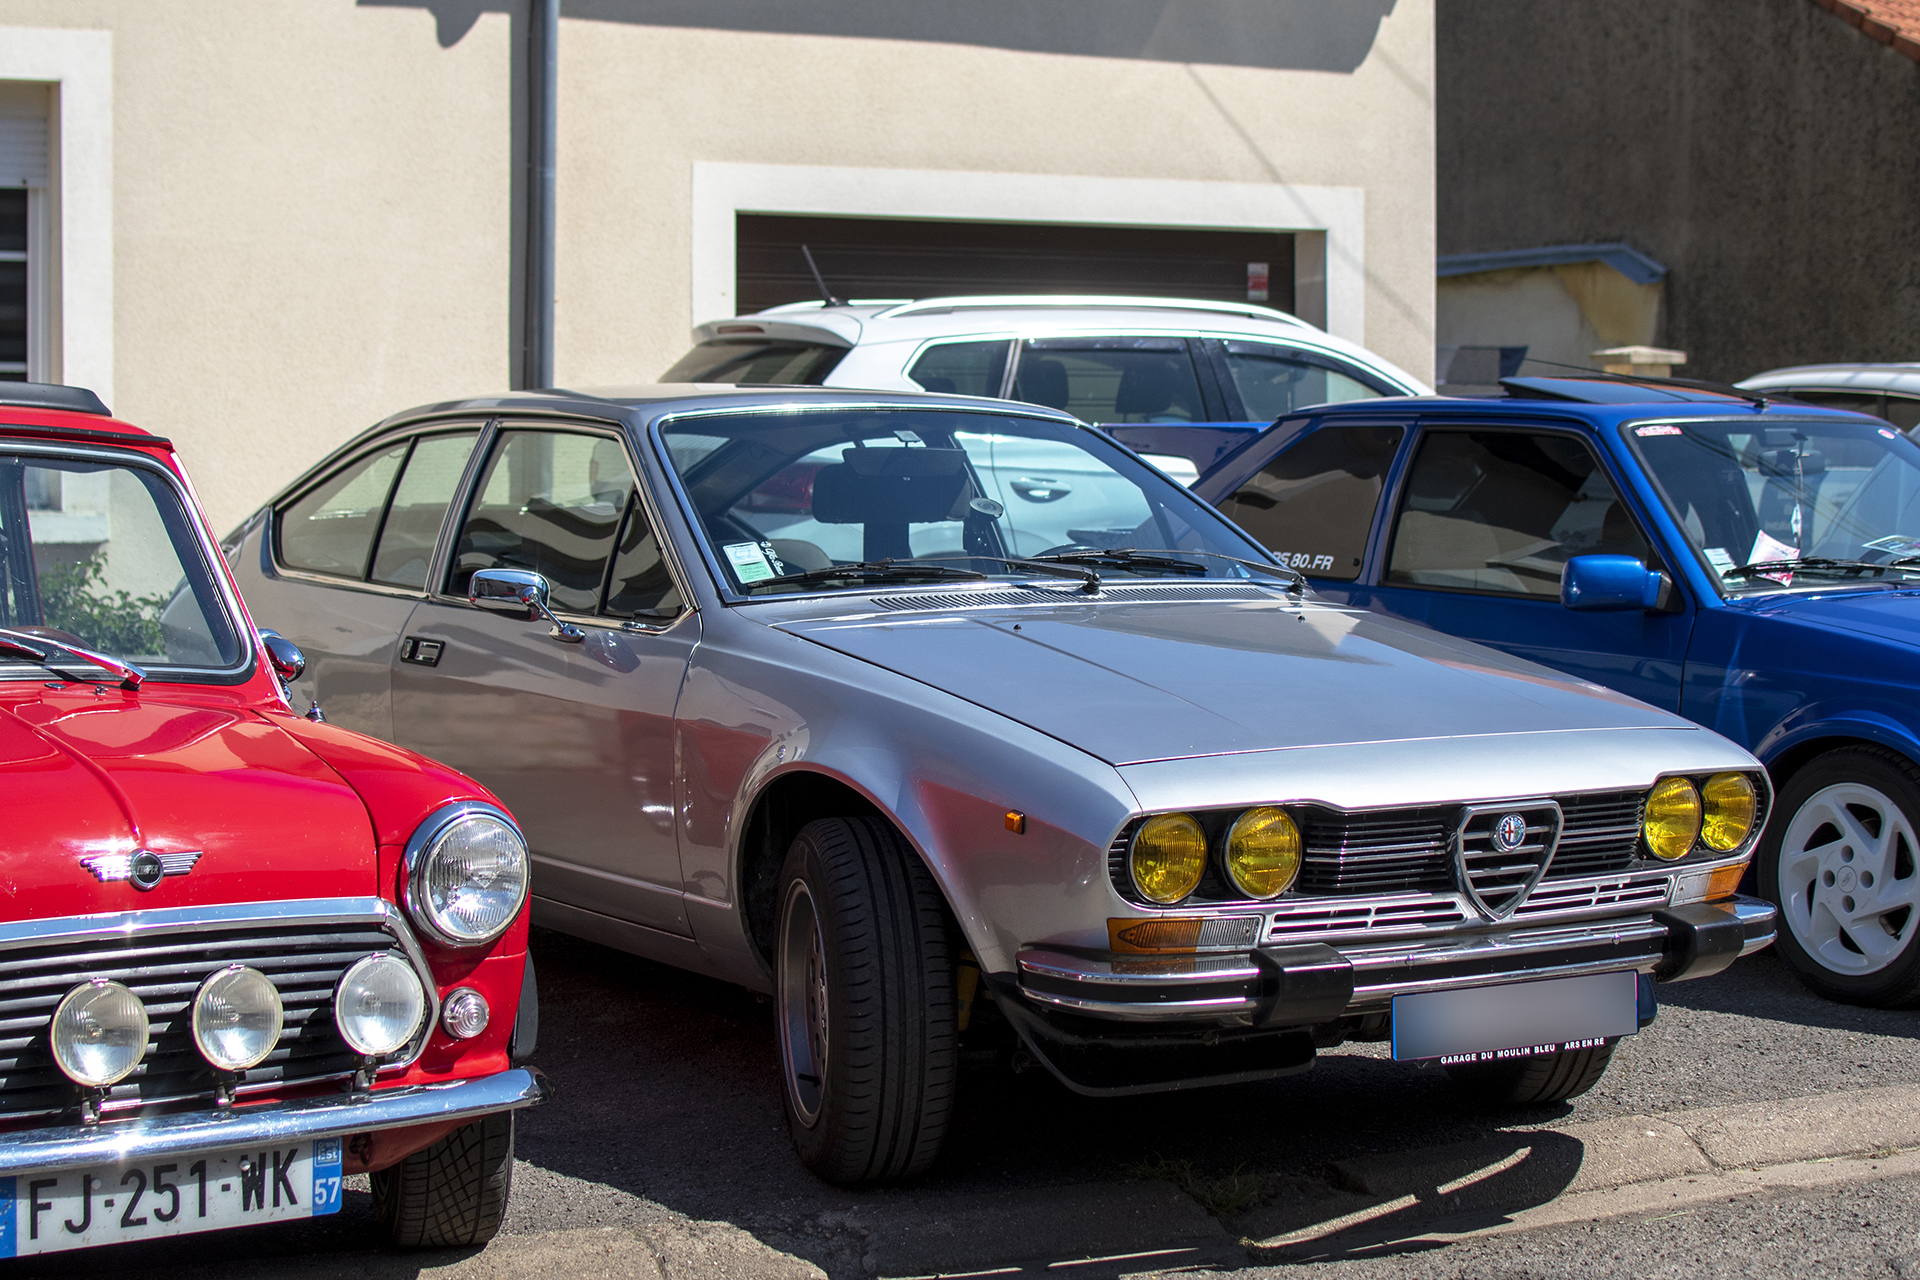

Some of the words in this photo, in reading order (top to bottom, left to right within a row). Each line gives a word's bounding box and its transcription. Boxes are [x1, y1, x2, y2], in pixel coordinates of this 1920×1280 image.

[1440, 1053, 1477, 1065] GARAGE
[1481, 1051, 1493, 1060] DU
[1497, 1047, 1530, 1058] MOULIN
[1534, 1044, 1556, 1054] BLEU
[1564, 1040, 1581, 1050] ARS
[1581, 1039, 1593, 1048] EN
[317, 1139, 339, 1149] Grand
[317, 1147, 338, 1161] Est
[29, 1148, 299, 1240] FJ-251-WK
[314, 1176, 340, 1205] 57
